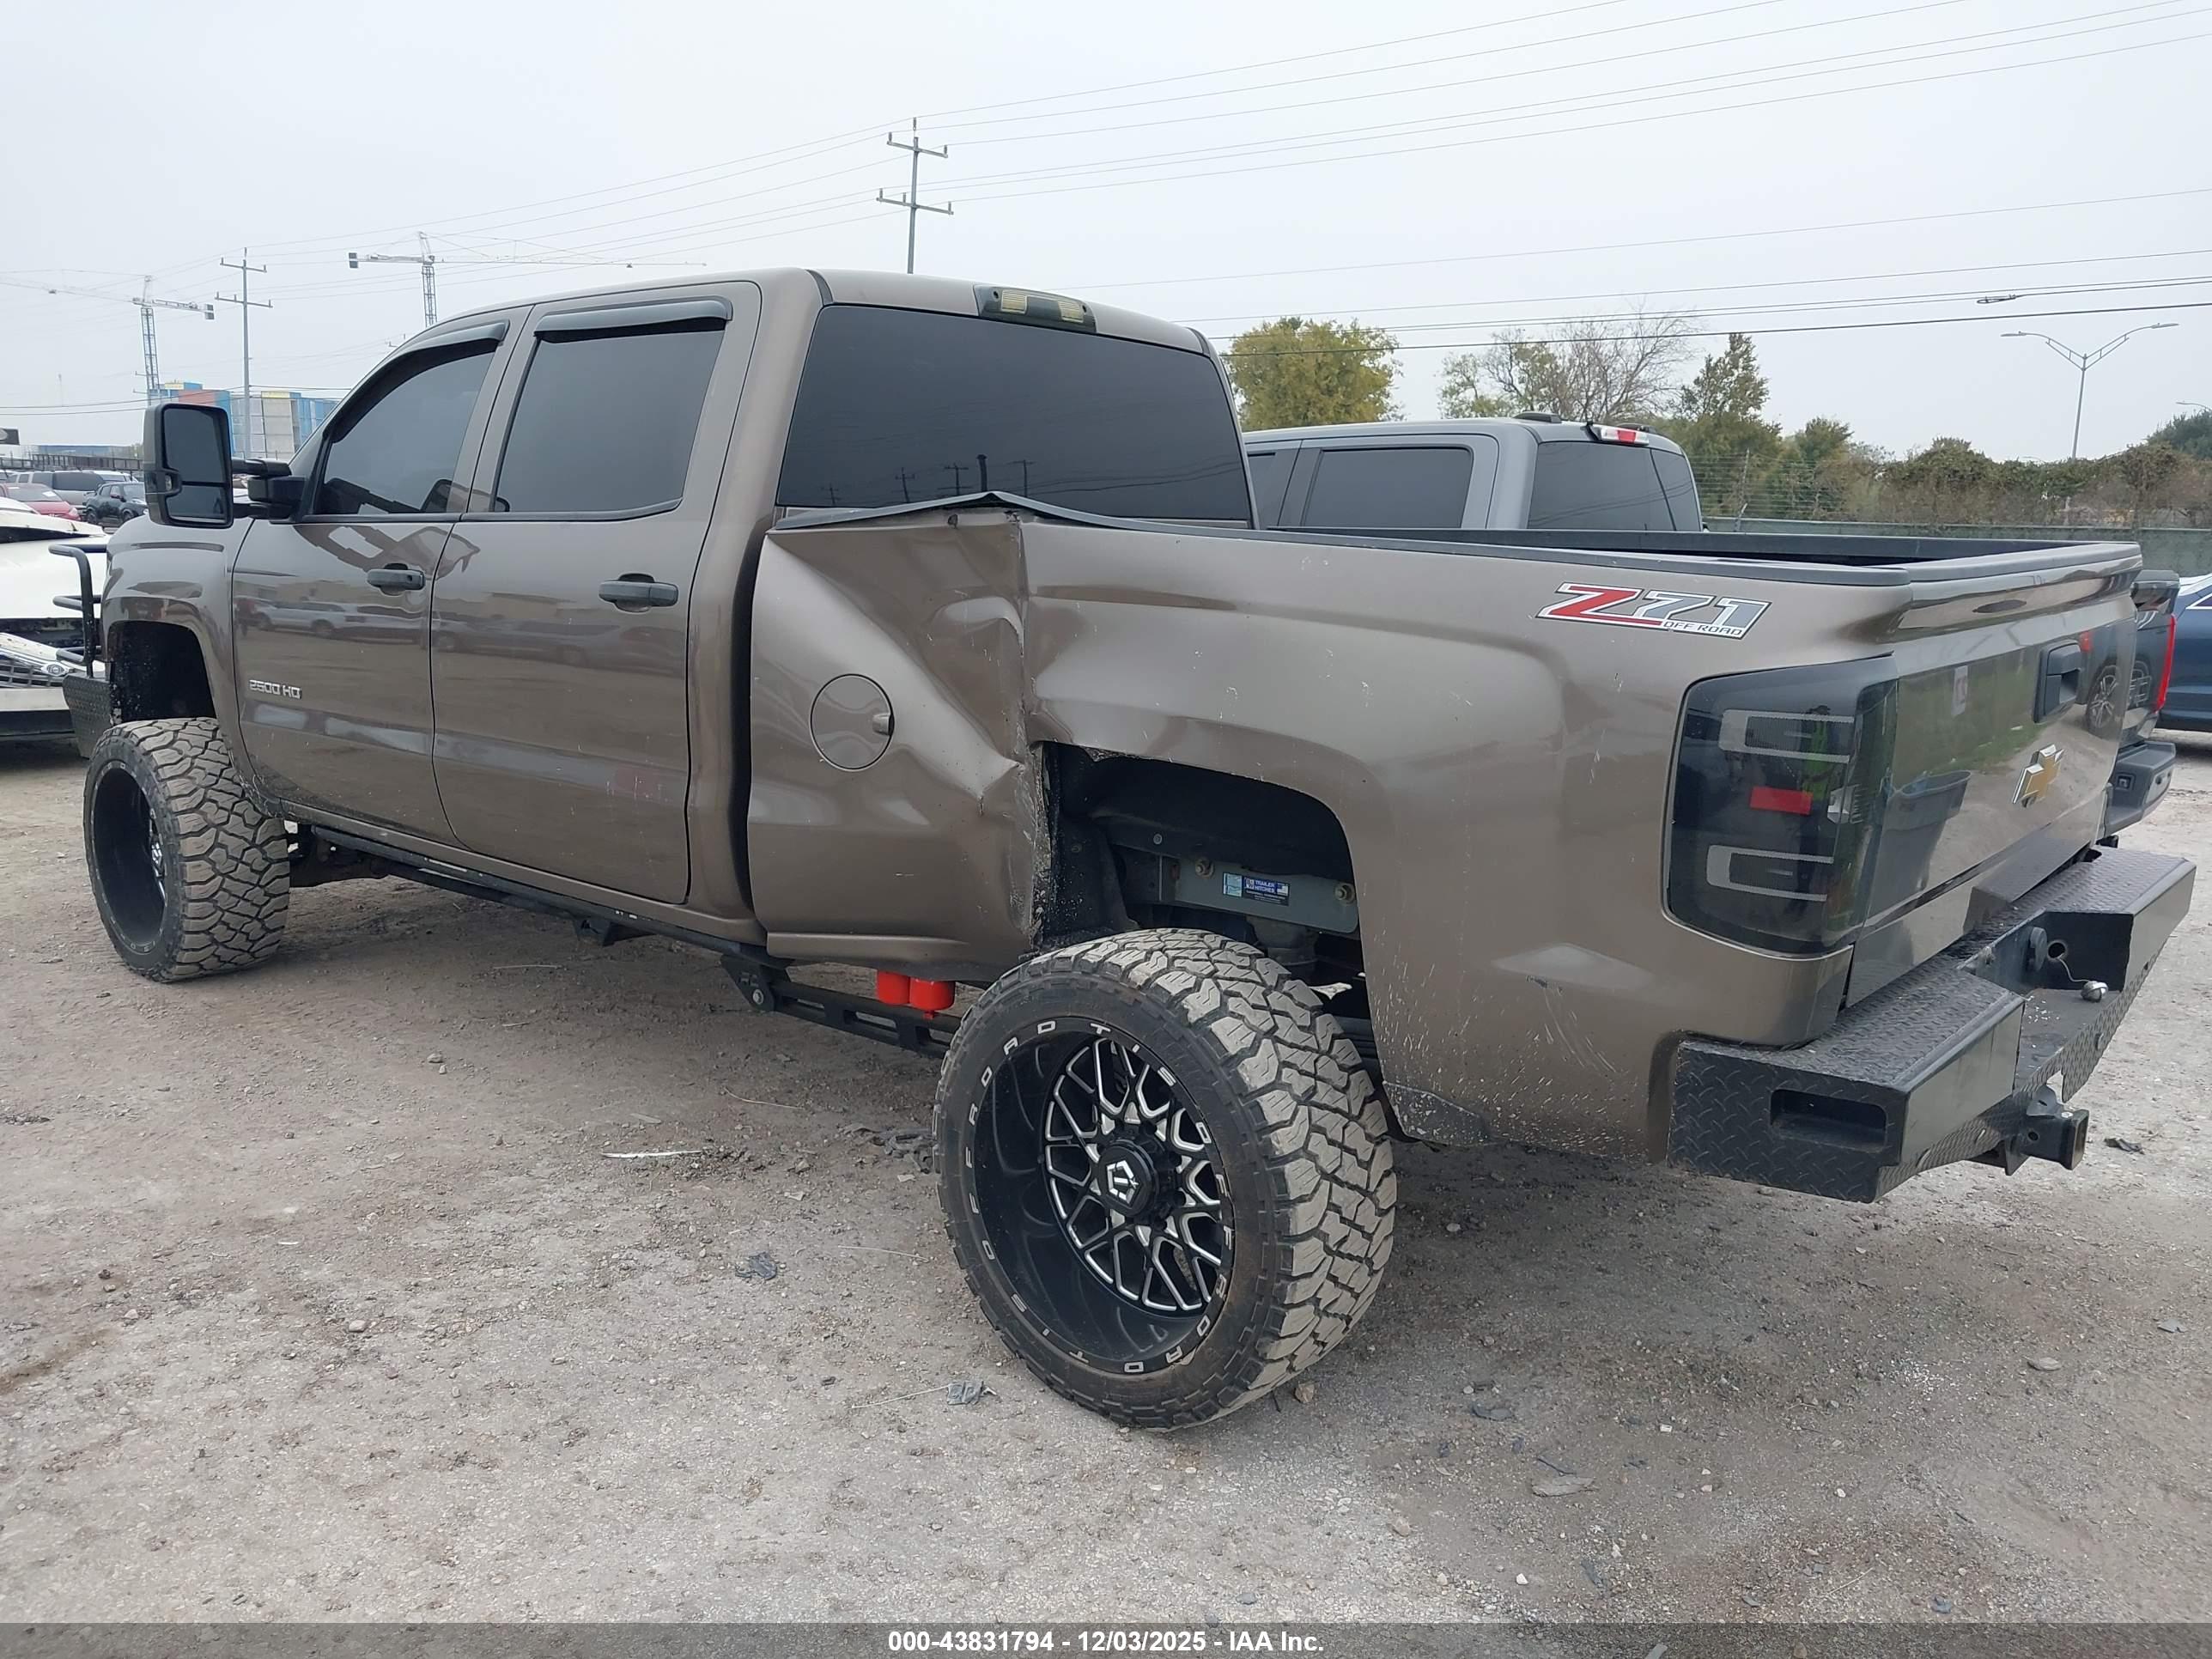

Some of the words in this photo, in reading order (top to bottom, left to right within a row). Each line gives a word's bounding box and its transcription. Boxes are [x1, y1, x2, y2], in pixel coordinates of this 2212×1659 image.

[1535, 581, 1772, 635] Z71
[1662, 620, 1695, 630] OFF
[1696, 624, 1743, 636] ROAD
[249, 679, 281, 696] 2500
[282, 684, 301, 700] HD
